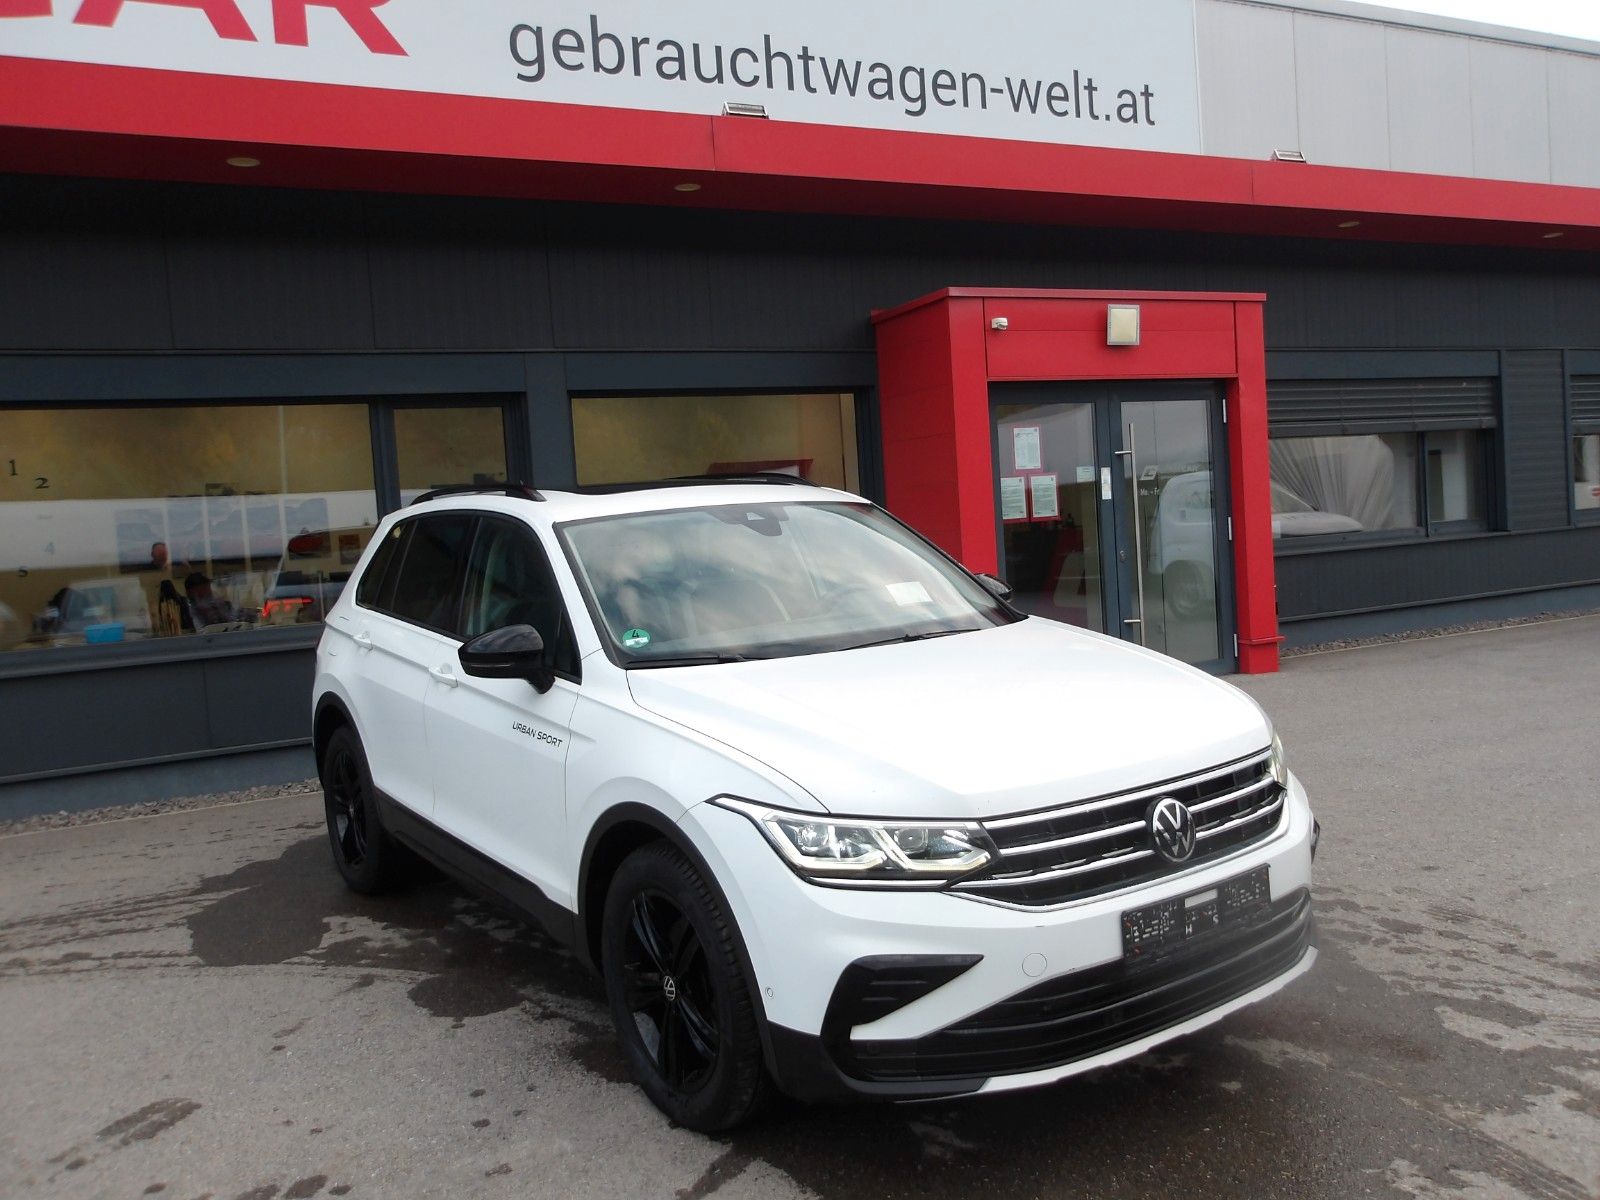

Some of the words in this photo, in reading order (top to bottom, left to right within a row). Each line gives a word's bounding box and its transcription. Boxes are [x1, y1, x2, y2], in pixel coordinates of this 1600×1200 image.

[509, 14, 1155, 126] gebrauchtwagen-welt.at
[35, 477, 50, 490] 2
[632, 629, 640, 638] 4
[512, 721, 537, 738] URBAN
[536, 731, 563, 748] SPORT
